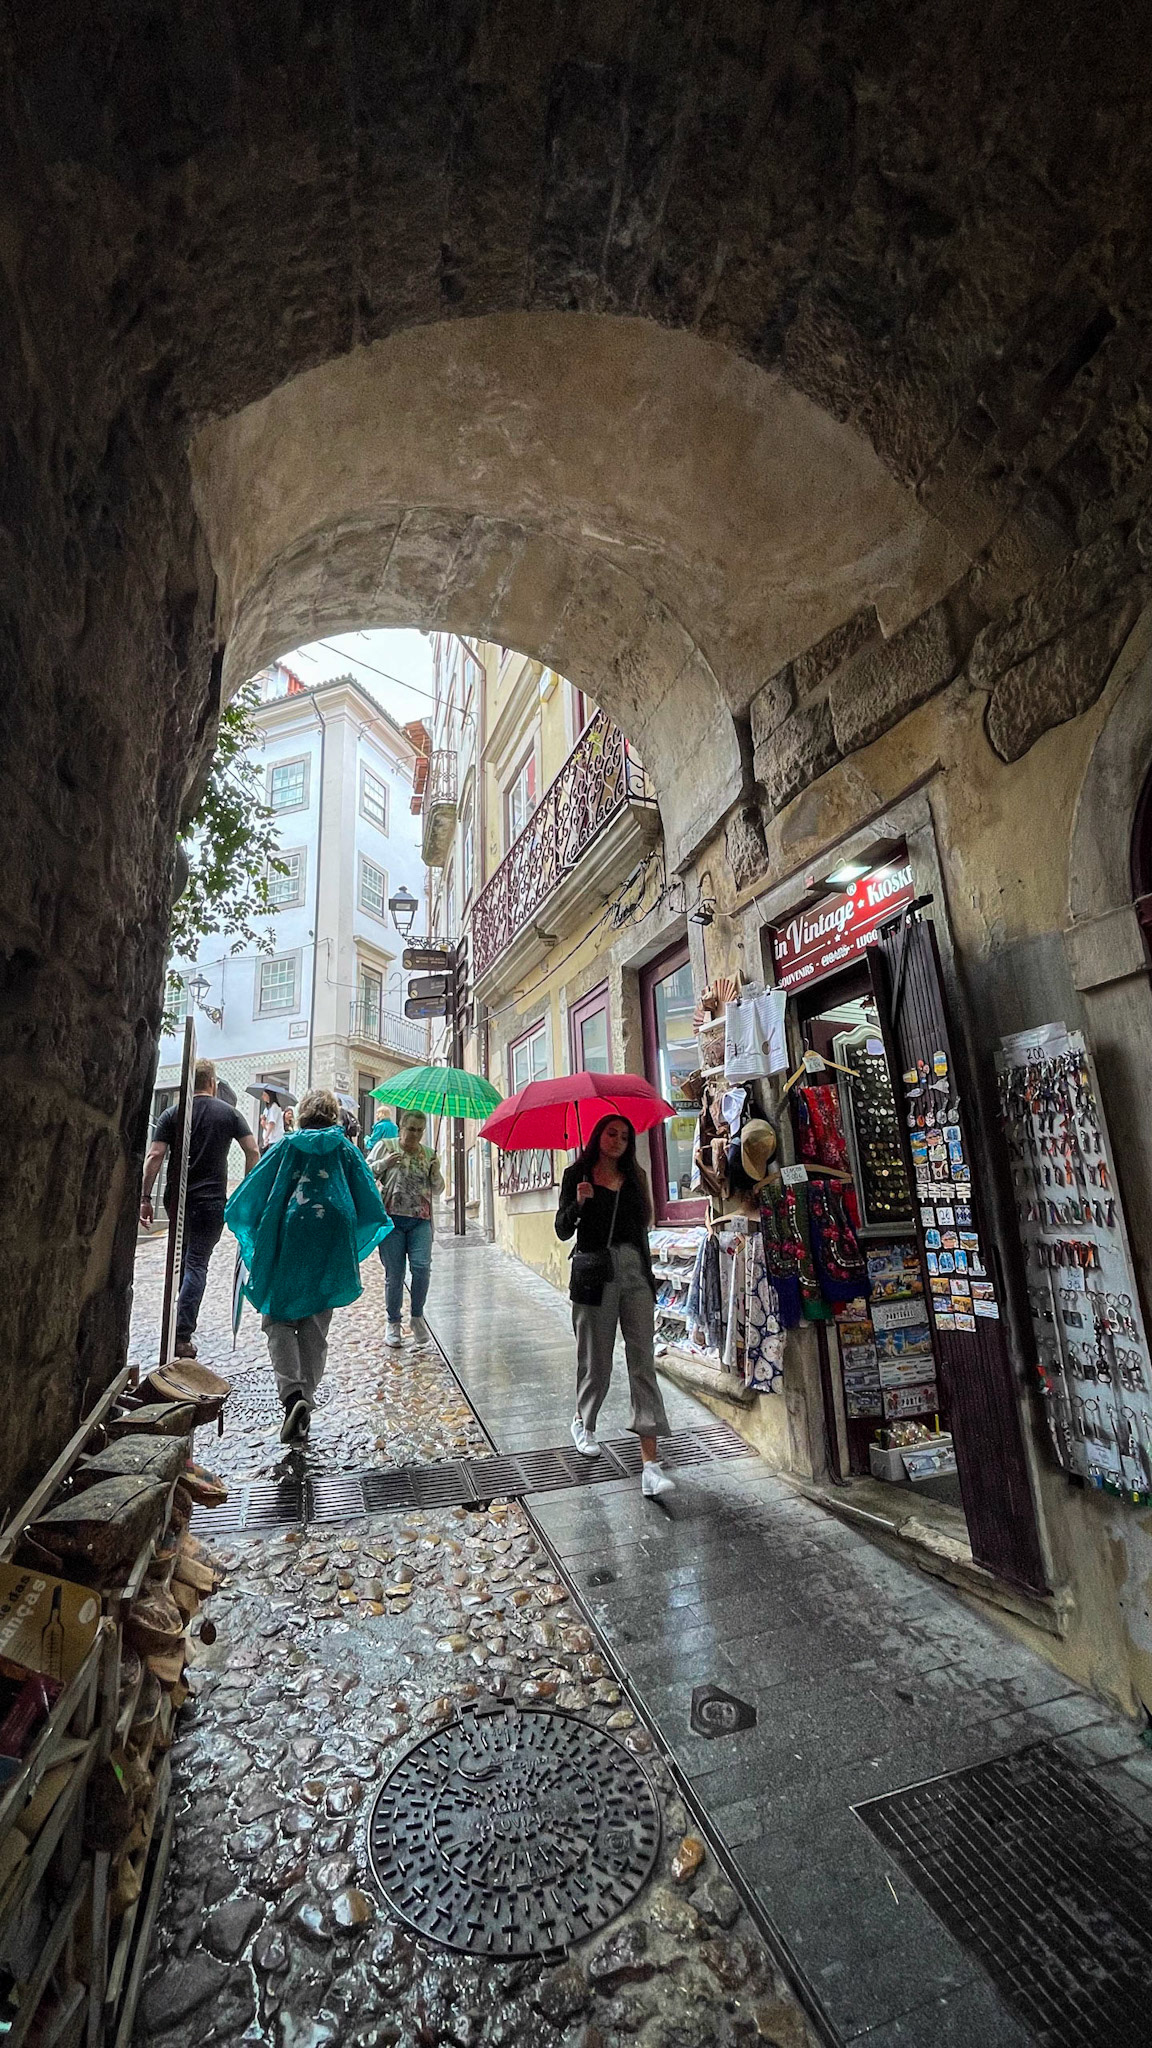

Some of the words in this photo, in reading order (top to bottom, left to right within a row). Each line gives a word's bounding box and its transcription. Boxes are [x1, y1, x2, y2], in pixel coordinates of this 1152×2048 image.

[773, 938, 788, 960] in
[786, 900, 855, 955] Vintage
[778, 962, 815, 989] SOUVENIRS
